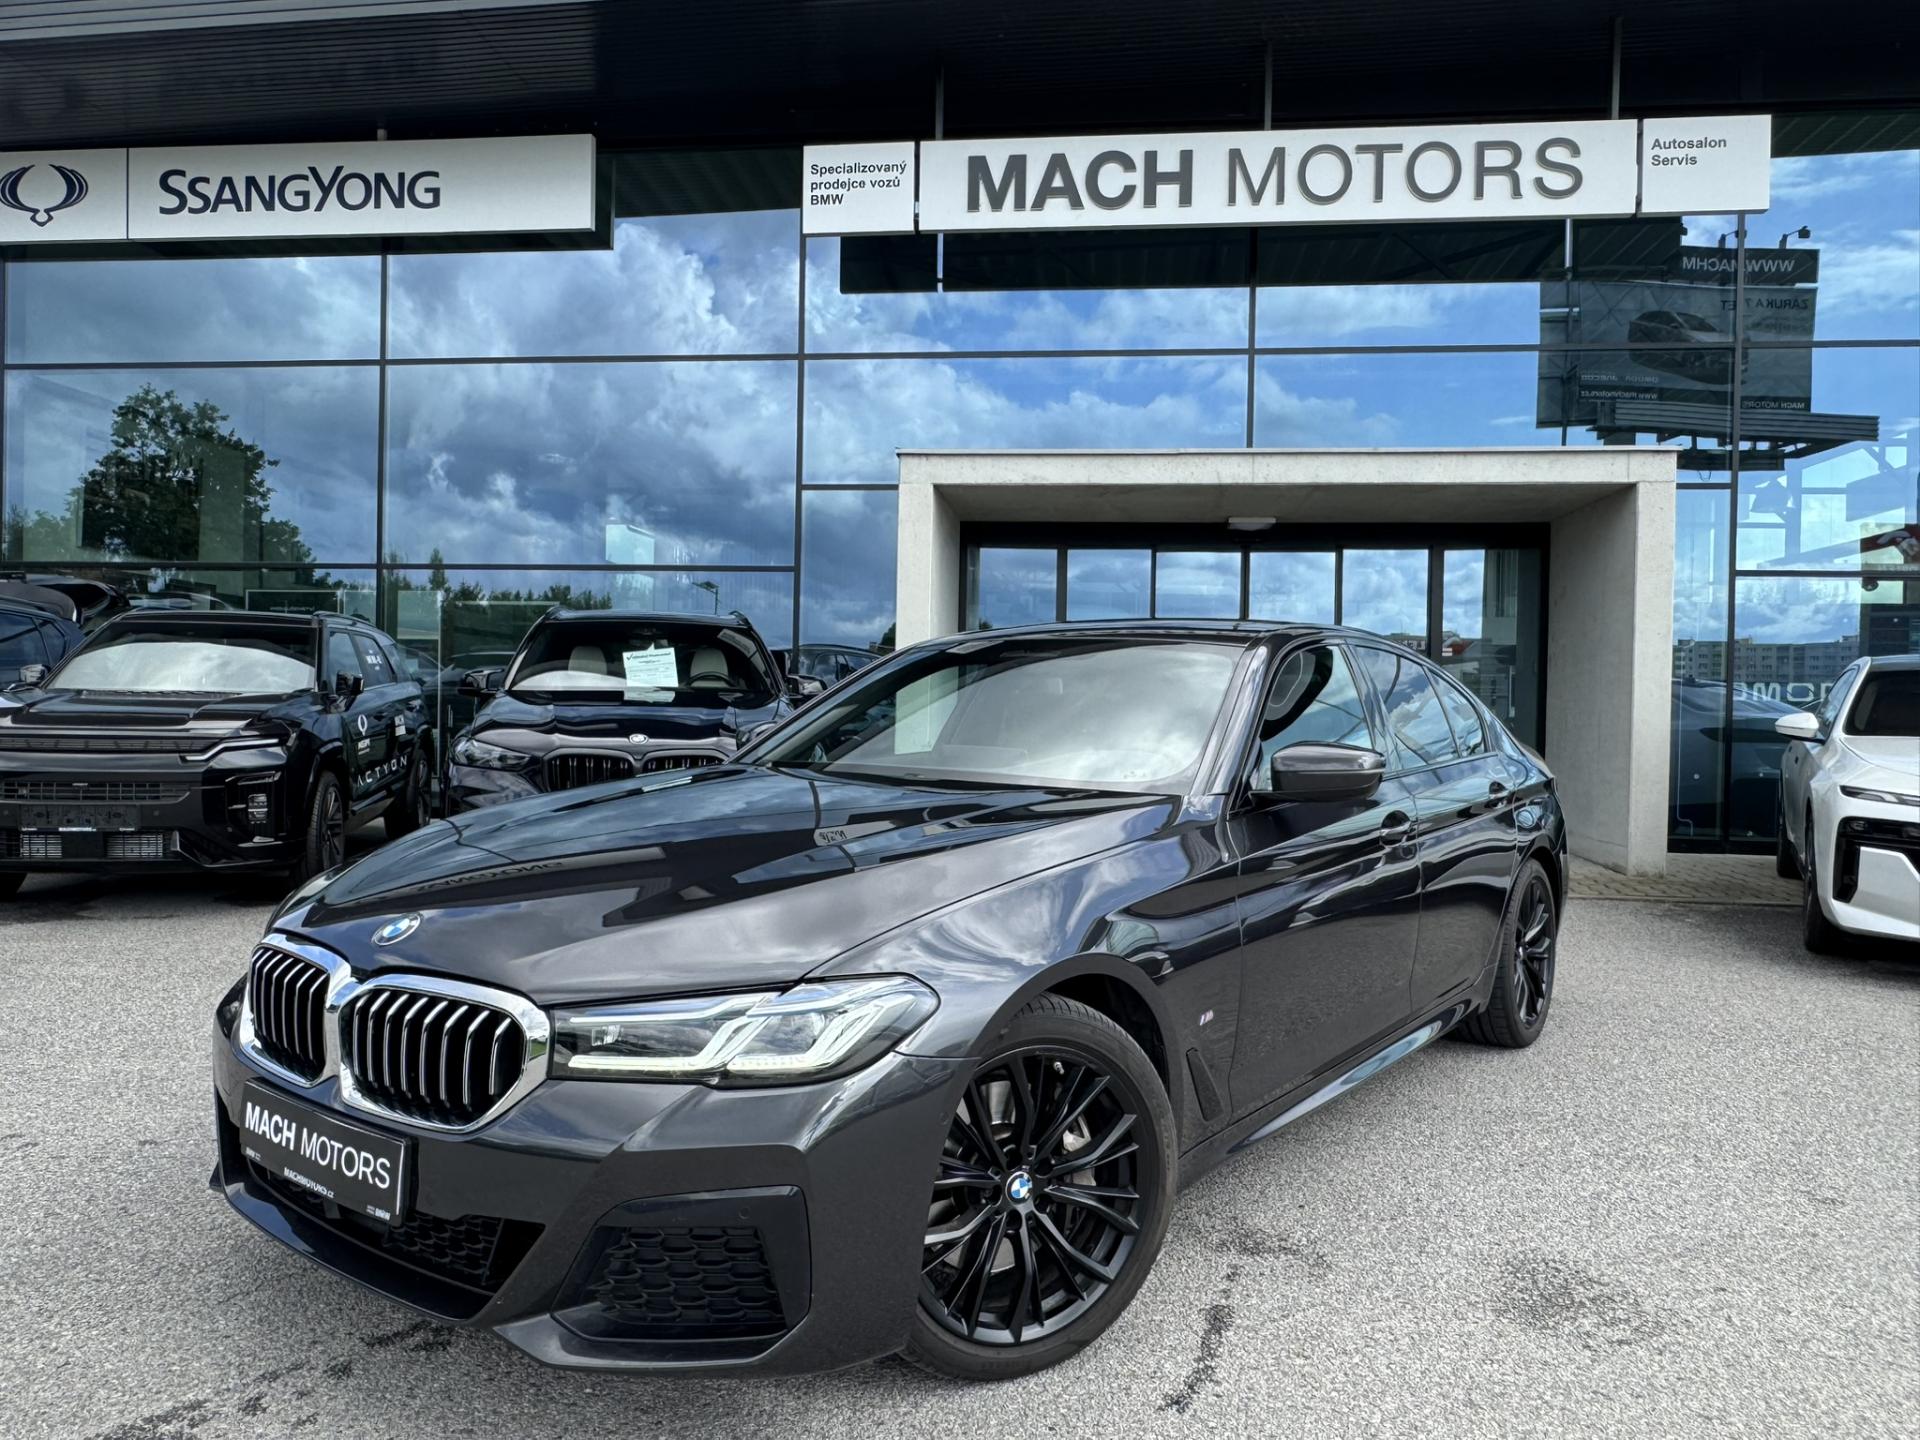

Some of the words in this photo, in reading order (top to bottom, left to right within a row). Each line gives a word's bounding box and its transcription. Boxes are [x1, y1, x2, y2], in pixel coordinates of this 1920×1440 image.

[1651, 137, 1727, 150] Autosalon
[1651, 154, 1698, 166] Servis
[810, 160, 907, 178] Specializovaný
[967, 149, 1194, 213] MACH
[1227, 137, 1585, 207] MOTORS
[810, 178, 866, 193] prodejce
[870, 176, 901, 189] vozů
[810, 193, 844, 206] BMW
[245, 1101, 297, 1151] MACH
[300, 1127, 391, 1189] MOTORS
